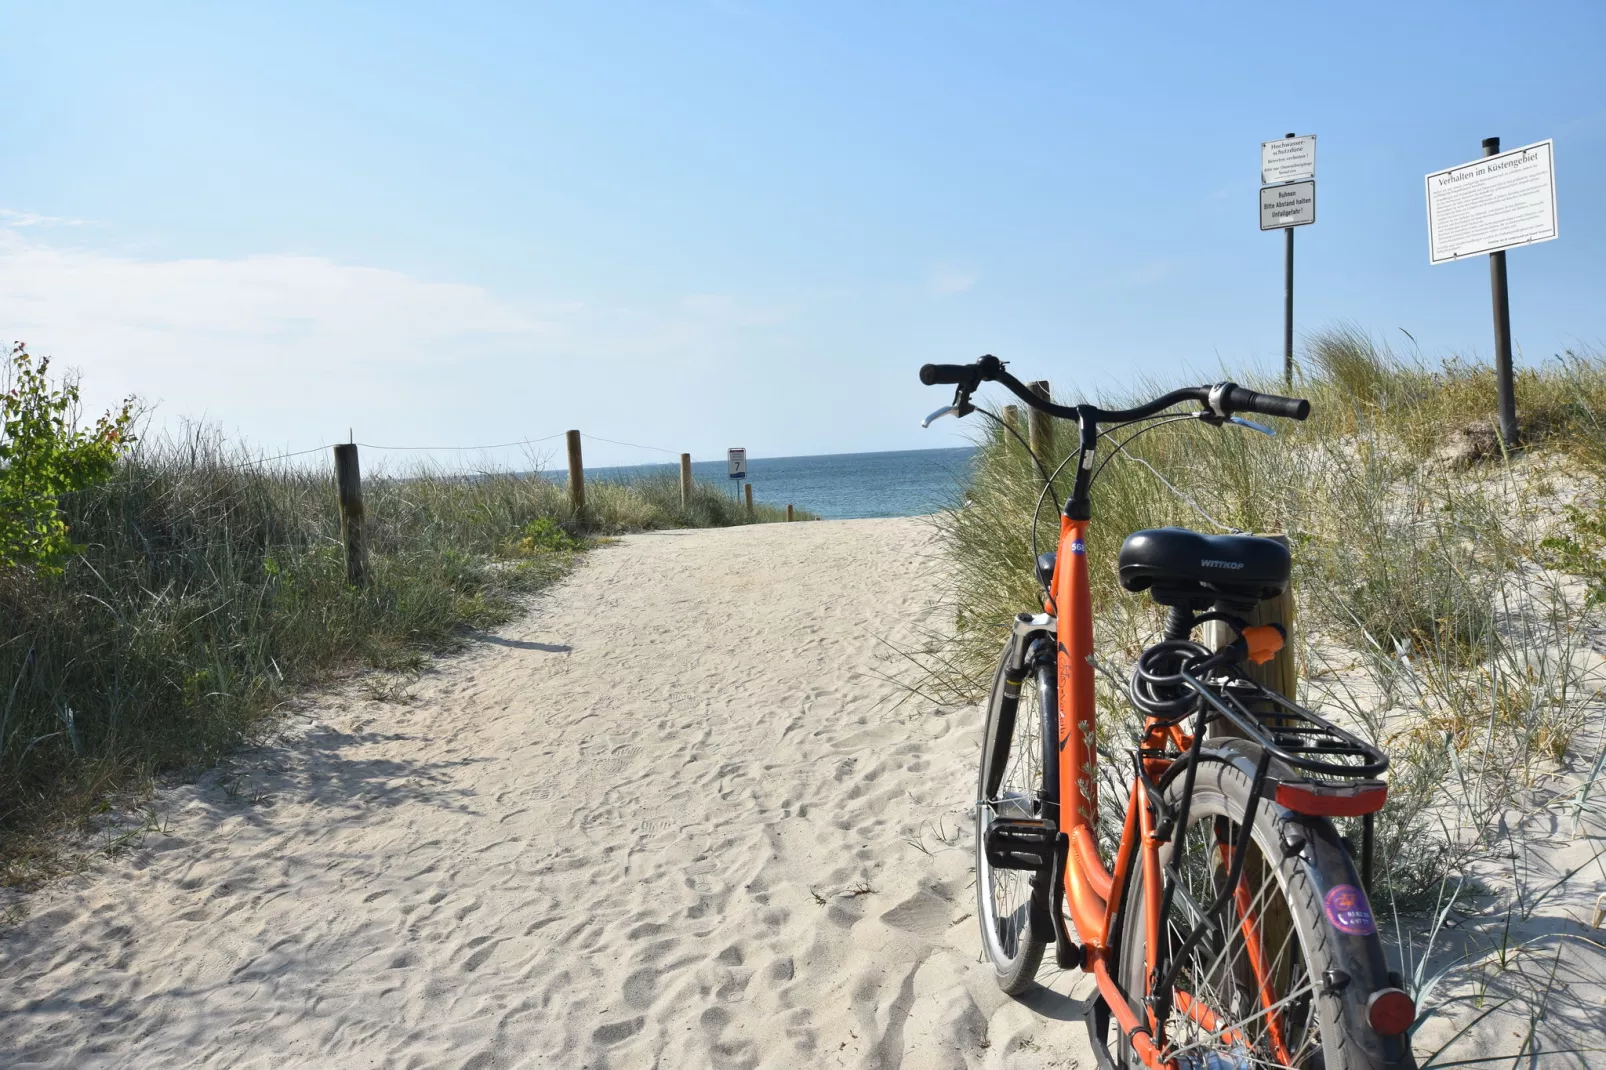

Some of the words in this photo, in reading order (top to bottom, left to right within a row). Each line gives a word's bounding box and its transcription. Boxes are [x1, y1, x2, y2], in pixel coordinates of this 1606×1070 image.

[1438, 171, 1474, 186] Verhalten
[1475, 167, 1486, 176] im
[1487, 153, 1538, 173] Küstengebiet
[1279, 191, 1297, 199] Buhnen
[1276, 200, 1295, 208] Abstand
[1295, 198, 1312, 206] halten
[735, 462, 740, 471] 7
[1201, 559, 1244, 569] WITTKOP
